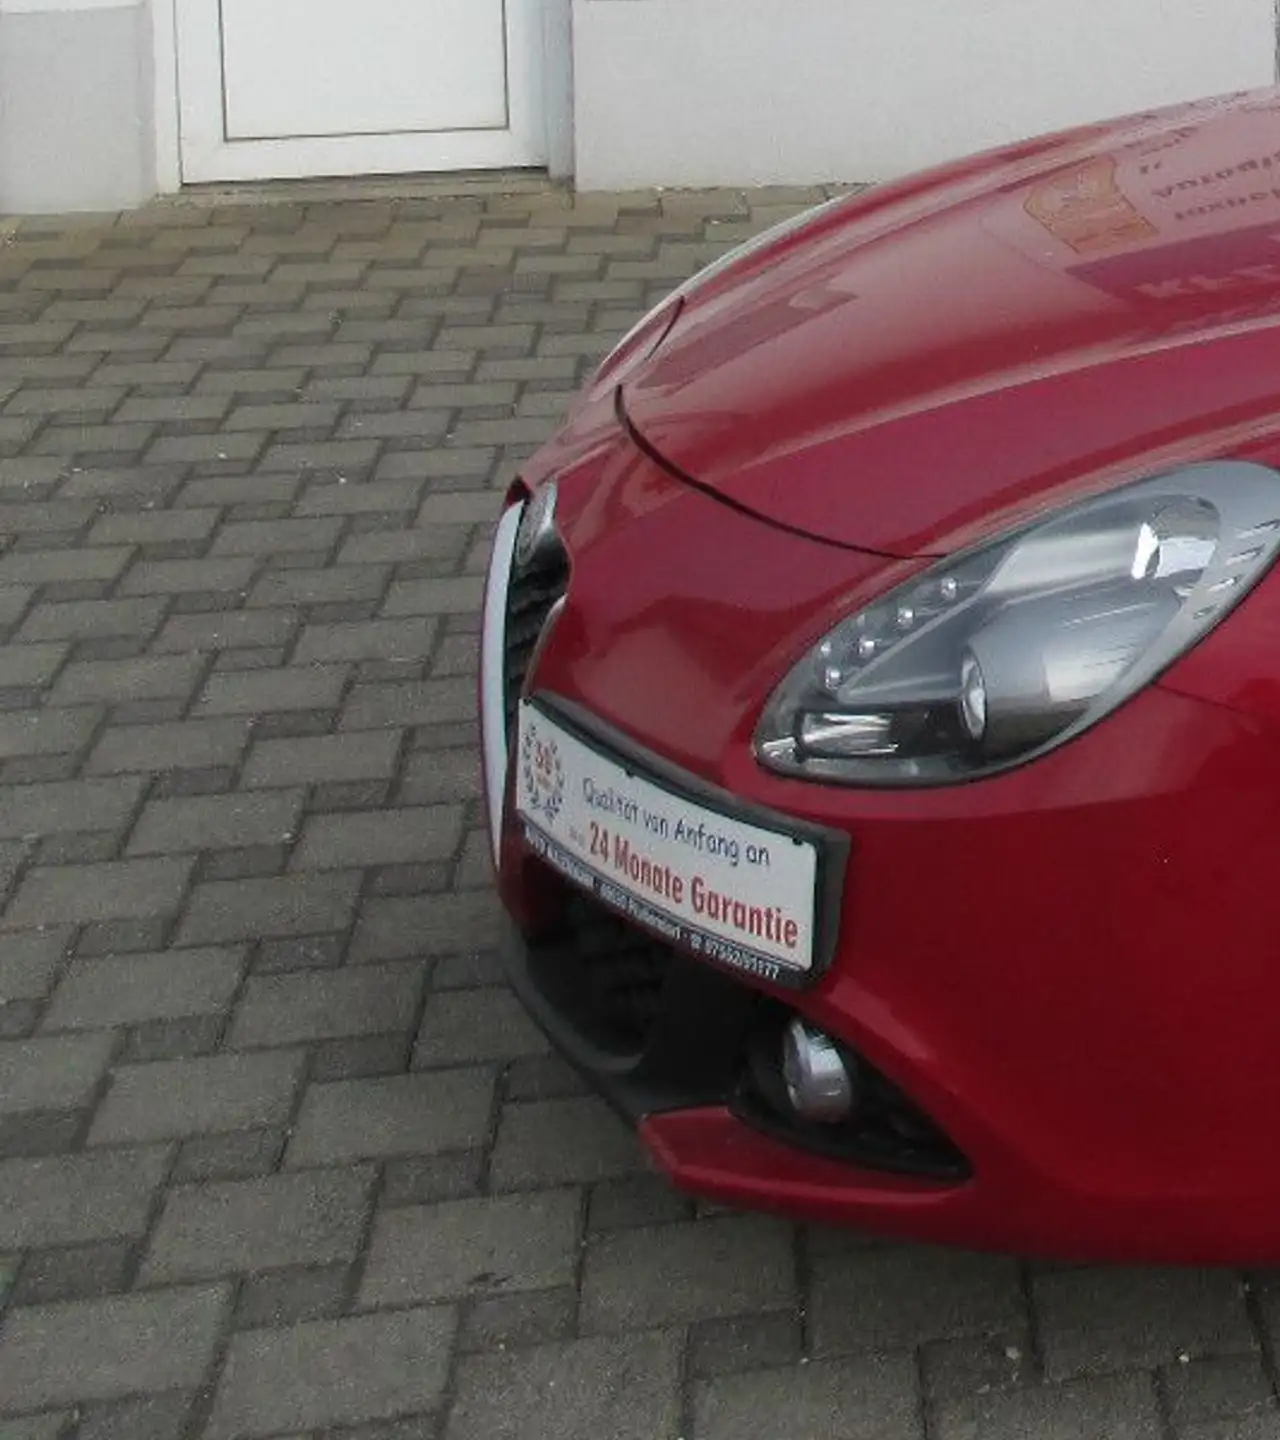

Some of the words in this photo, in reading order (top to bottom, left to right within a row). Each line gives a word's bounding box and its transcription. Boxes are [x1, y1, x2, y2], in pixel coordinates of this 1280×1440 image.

[590, 820, 609, 863] 24
[614, 833, 684, 904] Monate
[691, 876, 799, 949] Garantie
[745, 845, 770, 867] an
